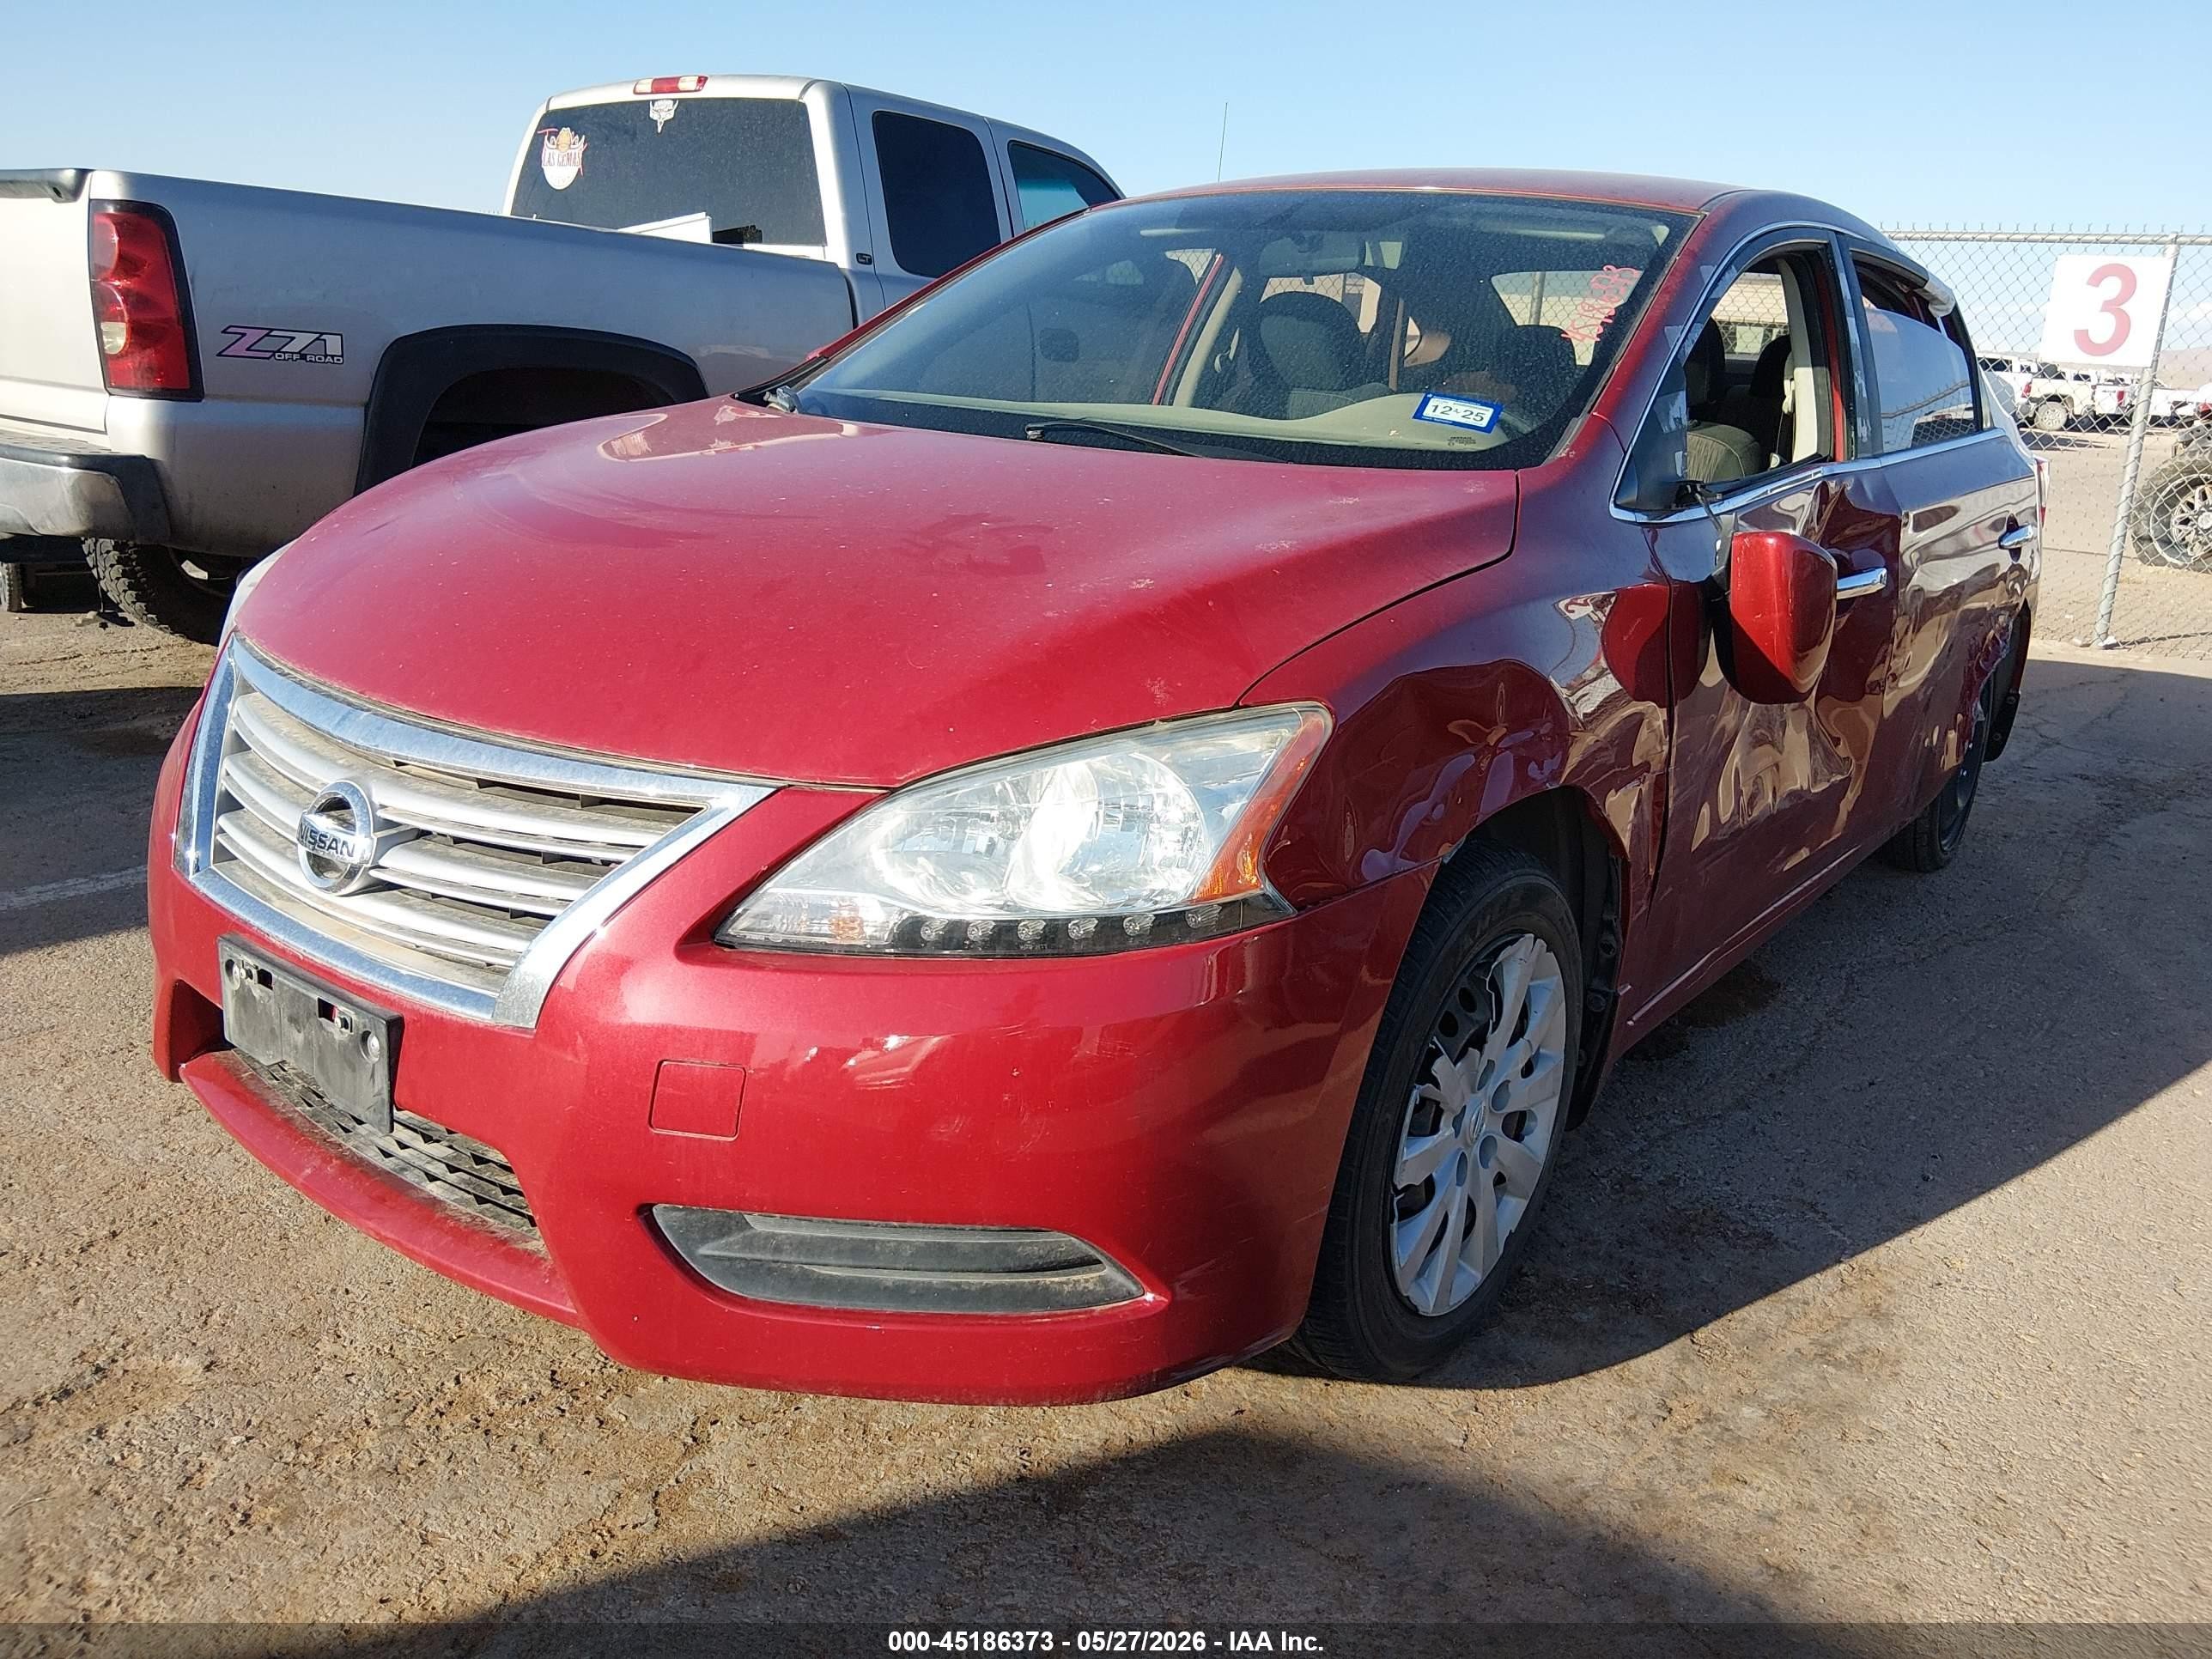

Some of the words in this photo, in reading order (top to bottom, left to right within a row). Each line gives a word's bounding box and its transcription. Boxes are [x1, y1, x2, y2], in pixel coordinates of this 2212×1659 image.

[2074, 263, 2137, 357] 3
[216, 325, 343, 359] Z71
[275, 351, 301, 362] OFF
[306, 354, 343, 364] ROAD
[1431, 404, 1453, 416] 12
[1461, 410, 1486, 422] 25
[299, 822, 356, 858] NISSAN
